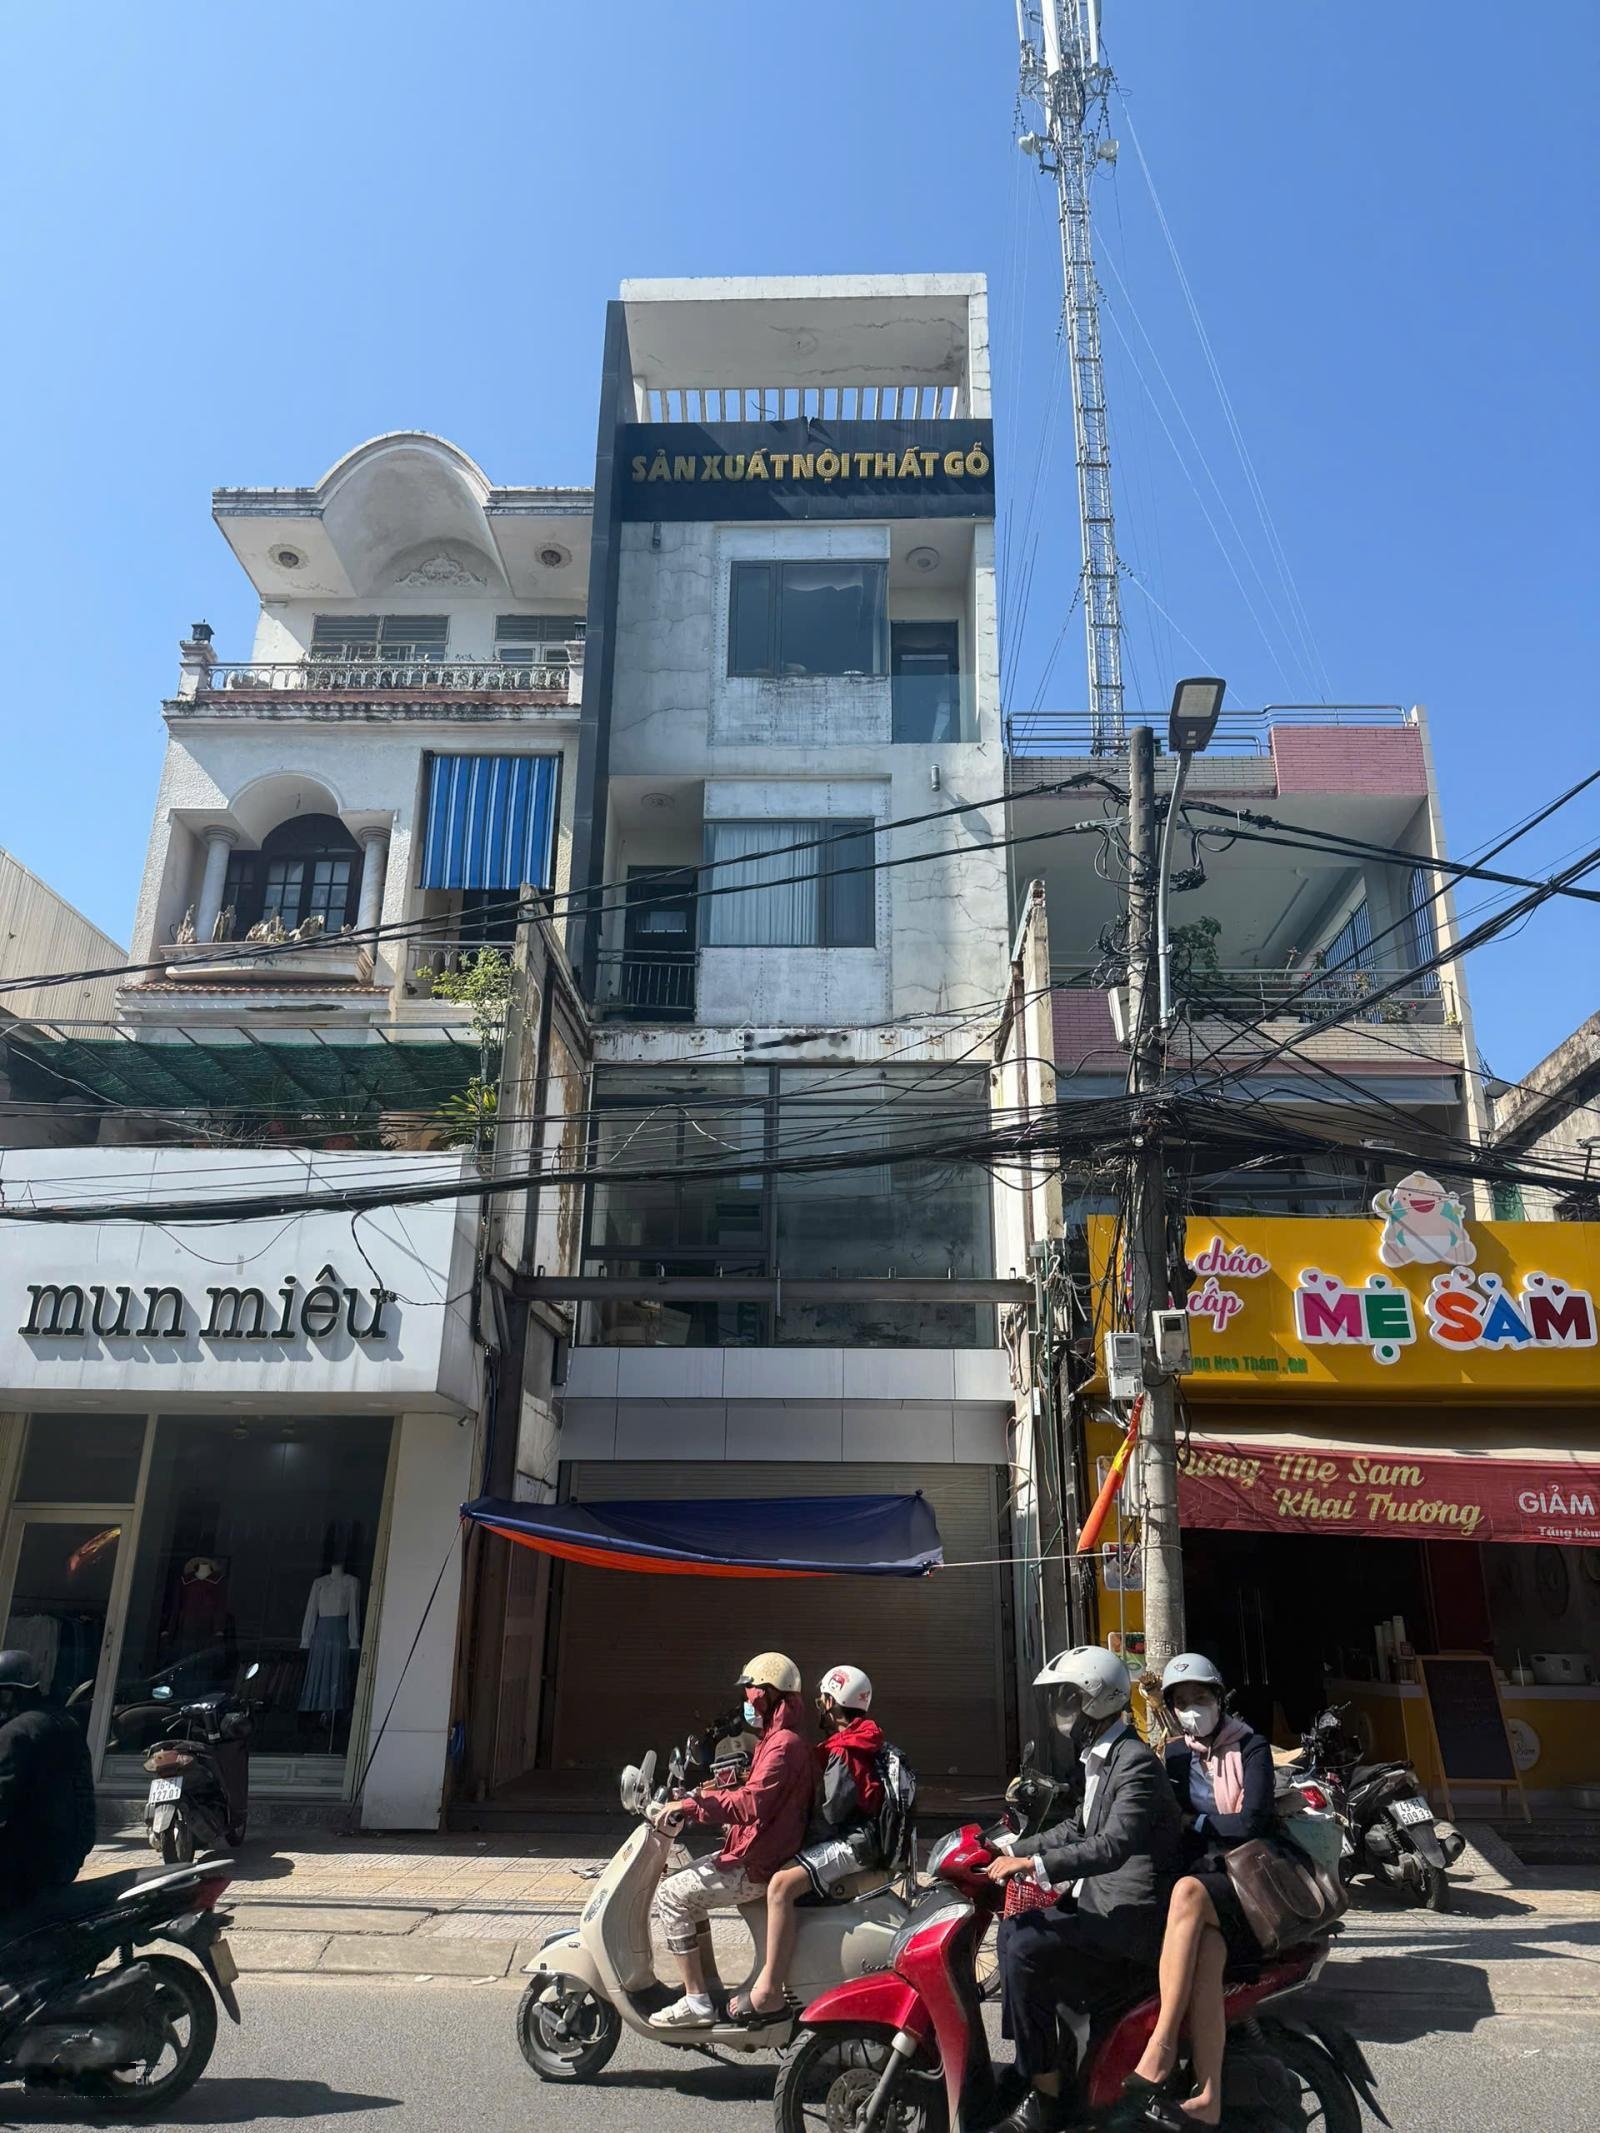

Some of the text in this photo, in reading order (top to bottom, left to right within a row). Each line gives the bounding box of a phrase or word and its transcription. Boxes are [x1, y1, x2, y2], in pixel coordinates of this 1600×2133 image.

[631, 441, 990, 484] SẢN XUẤT NỘI THẤT GỖ
[1198, 1237, 1269, 1272] cháo
[17, 1263, 388, 1341] mun miêu
[1188, 1280, 1242, 1330] cấp
[1301, 1288, 1595, 1360] MẸ SAM
[1273, 1453, 1340, 1488] Mẹ
[1348, 1455, 1424, 1487] Sam
[1272, 1487, 1485, 1537] Khai Trương
[1518, 1484, 1596, 1516] GIẢM
